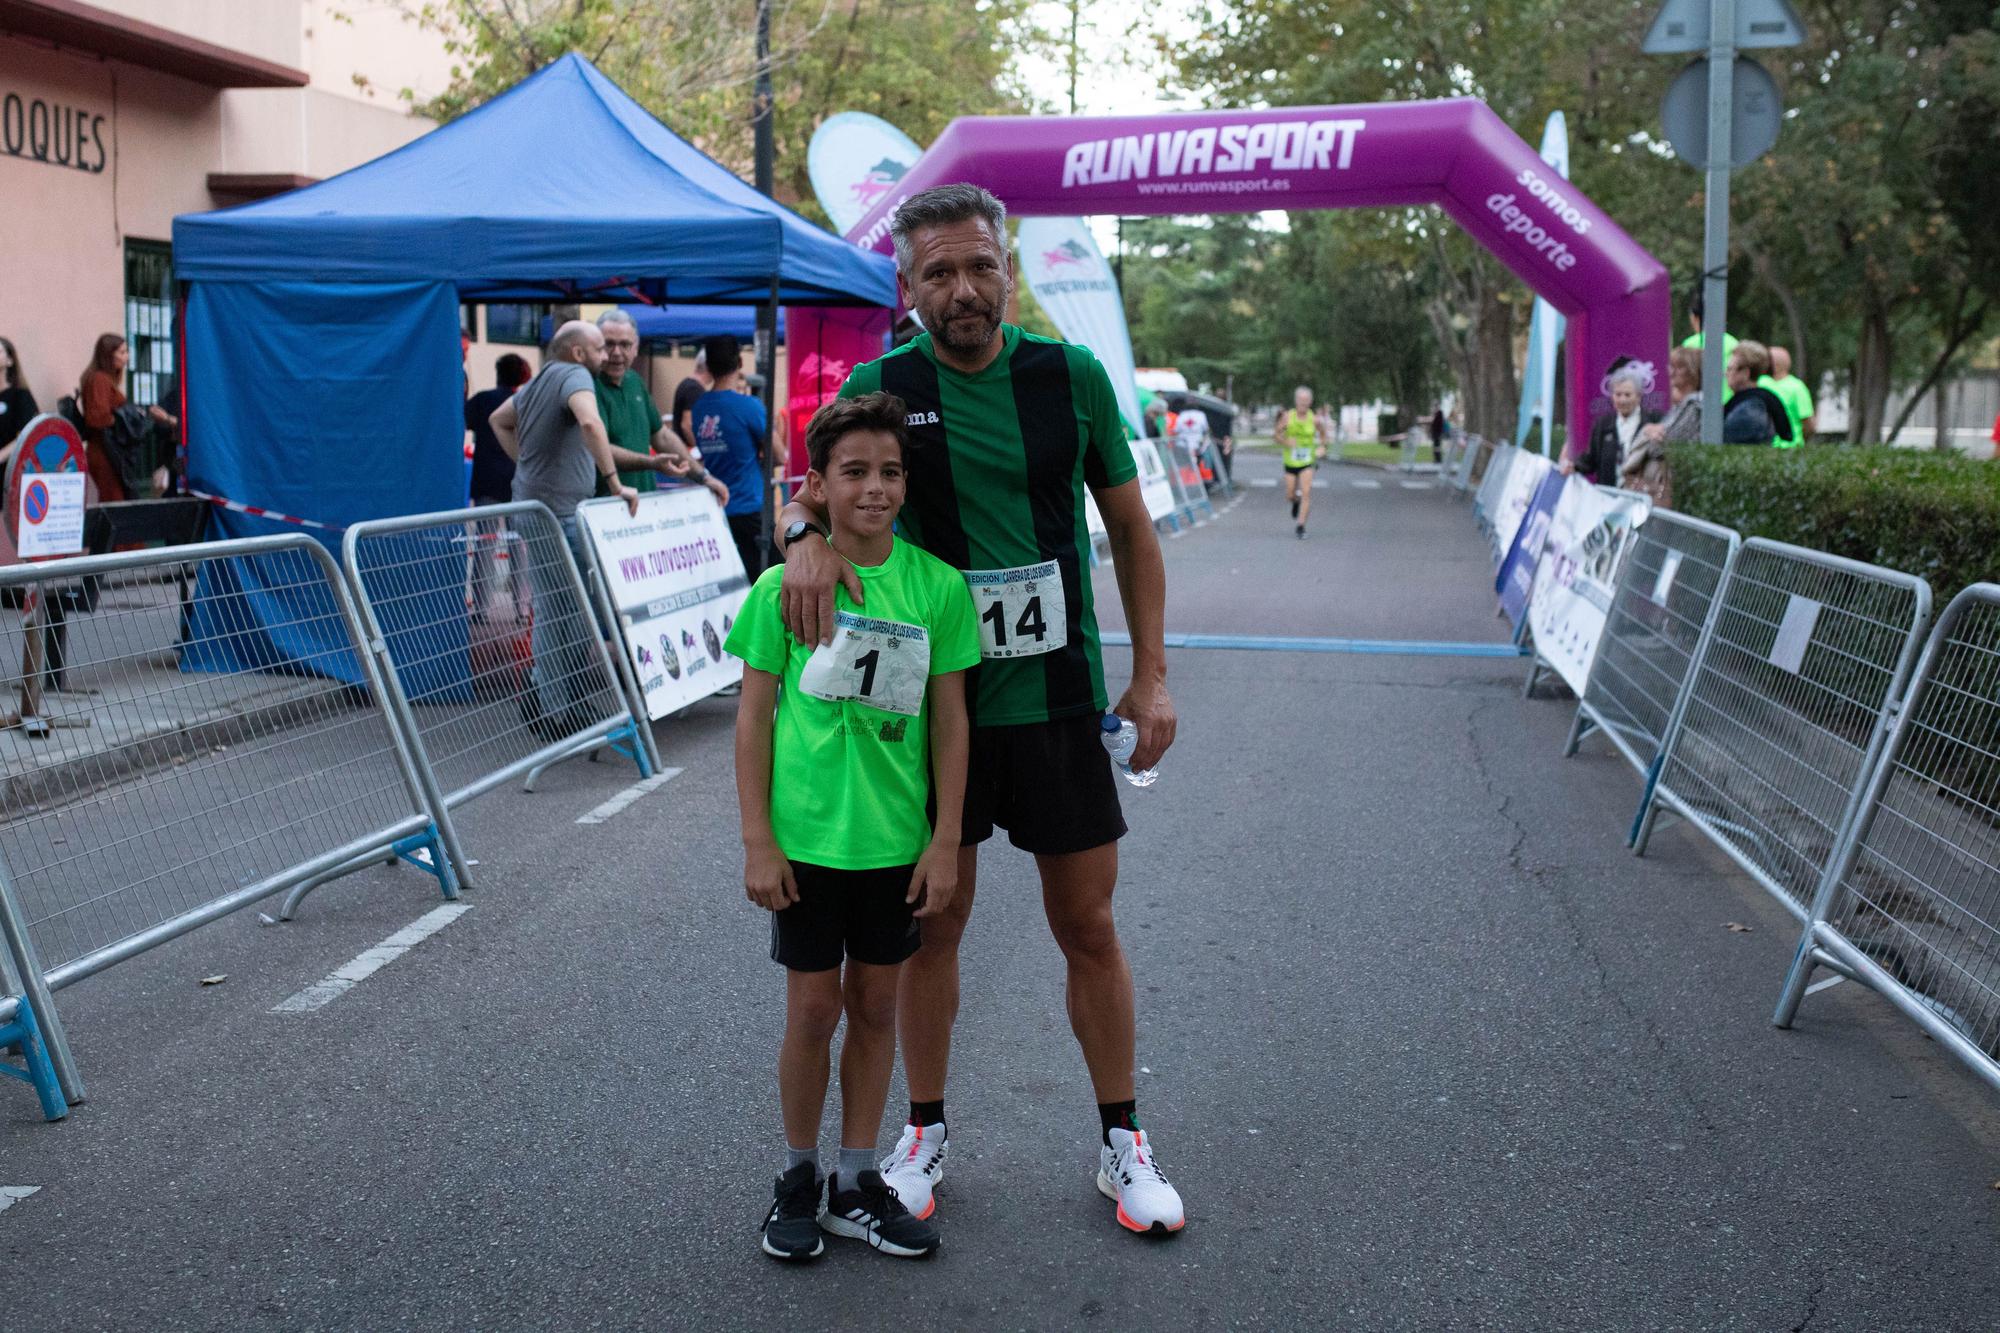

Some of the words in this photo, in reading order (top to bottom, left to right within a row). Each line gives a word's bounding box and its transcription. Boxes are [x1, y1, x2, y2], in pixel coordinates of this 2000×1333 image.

[1062, 119, 1366, 188] RUNVASPORT
[1137, 178, 1290, 195] www.runvasport.es
[1516, 169, 1592, 235] somos
[1486, 193, 1577, 272] deporte
[618, 536, 721, 583] www.runvasport.es
[971, 573, 1000, 584] EDICIÓN
[1003, 569, 1024, 583] CARRERA
[1024, 568, 1030, 581] DE
[1030, 567, 1039, 580] LOS
[869, 620, 890, 635] CARRERA
[890, 623, 897, 637] DE
[897, 624, 906, 638] LOS
[982, 595, 1047, 646] 14
[854, 649, 880, 696] 1
